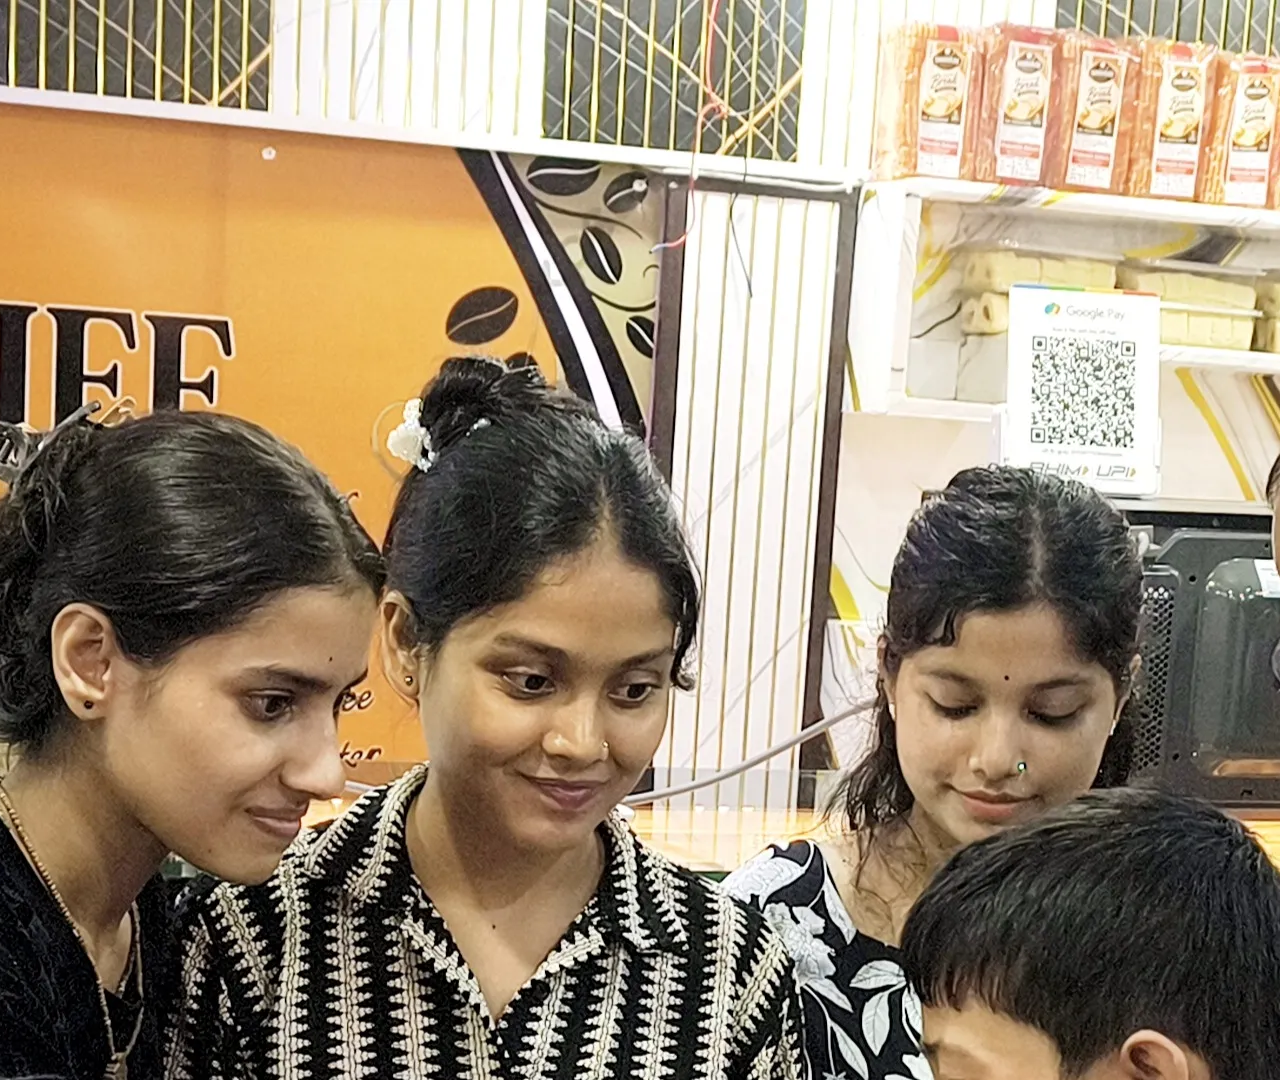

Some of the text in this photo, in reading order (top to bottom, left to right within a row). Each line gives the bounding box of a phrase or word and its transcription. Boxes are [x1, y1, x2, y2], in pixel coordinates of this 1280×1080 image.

[1066, 304, 1126, 321] Google Pay
[1096, 465, 1130, 478] UPI
